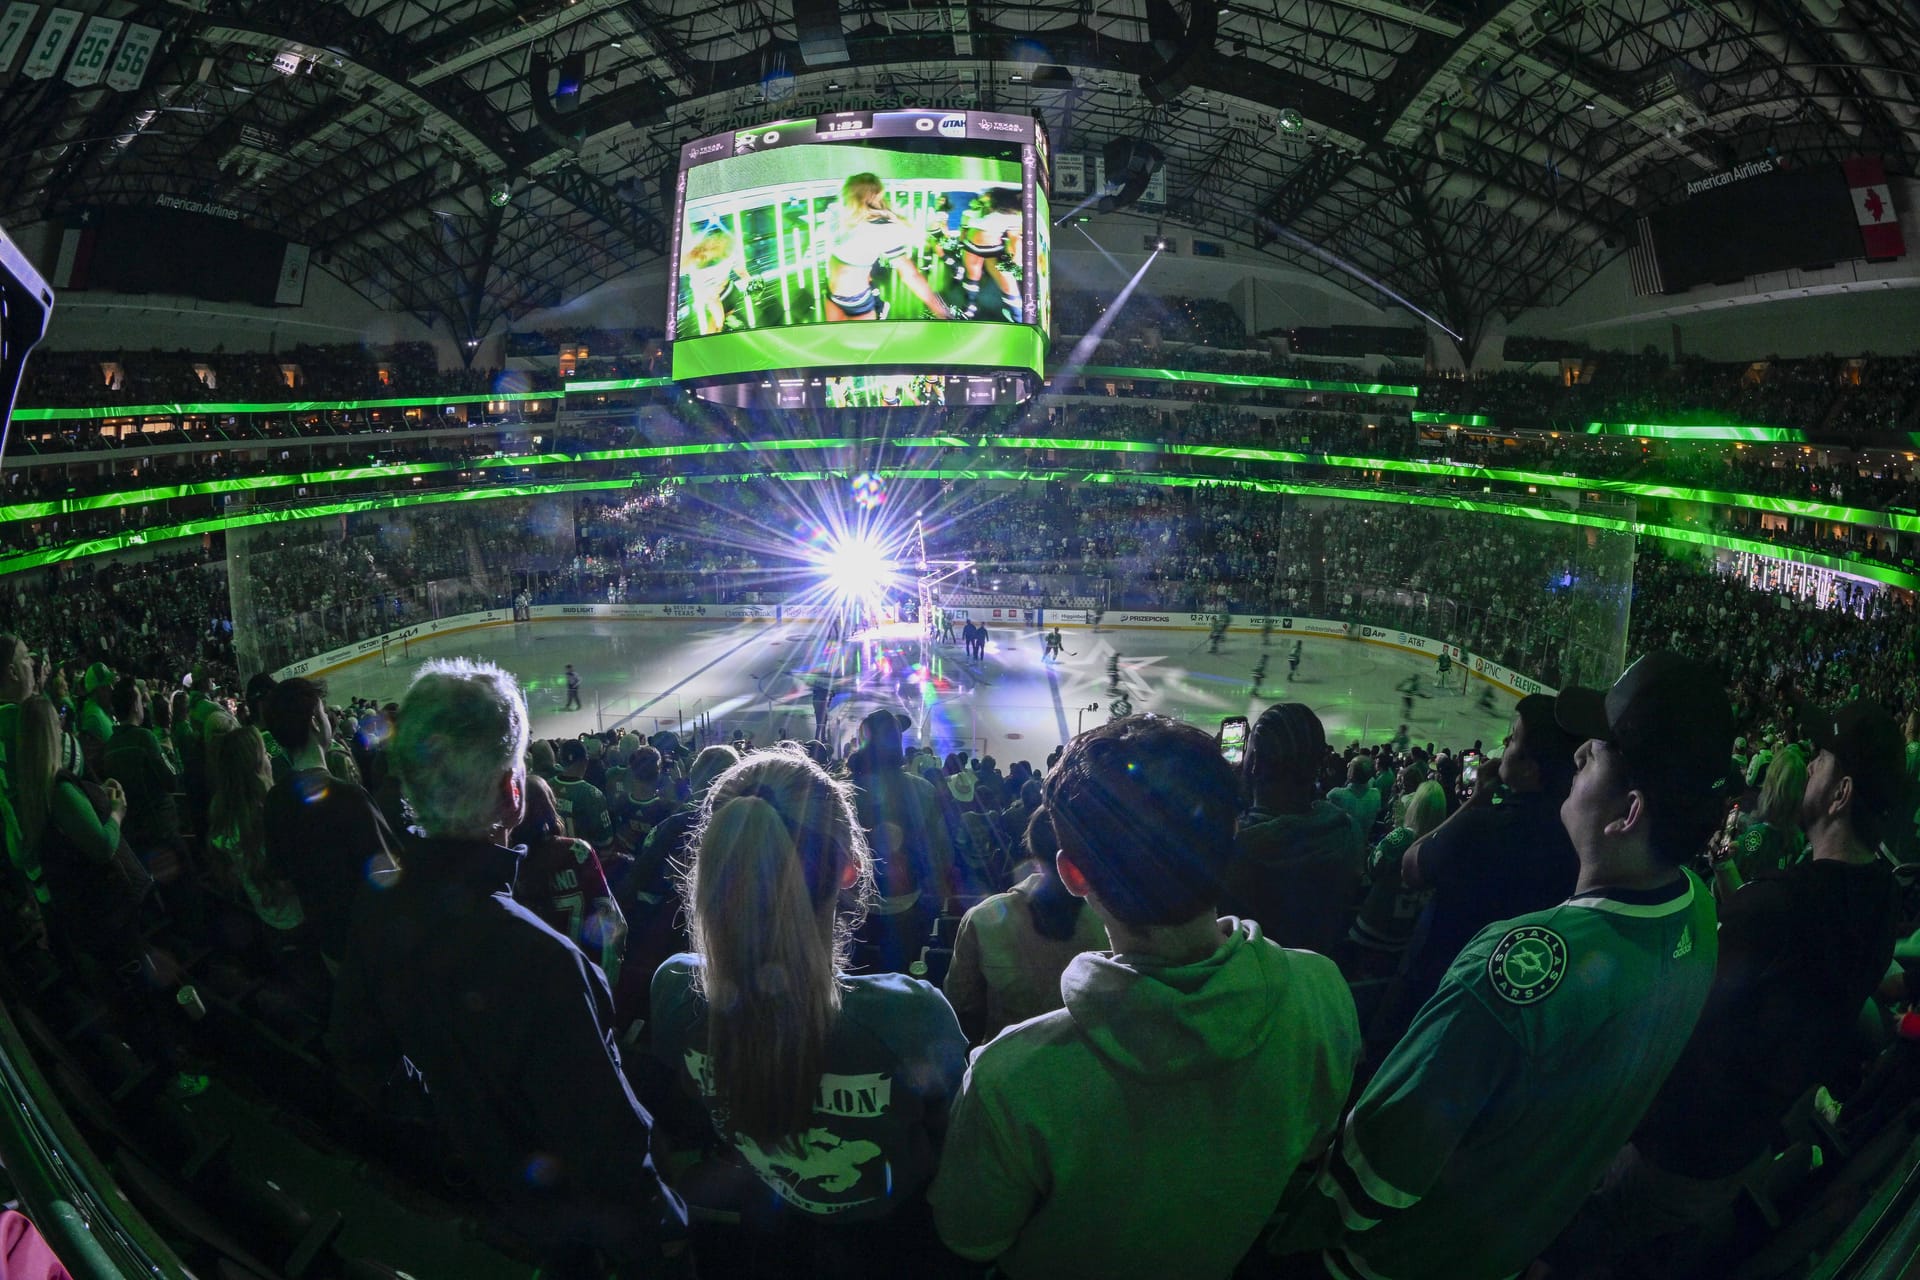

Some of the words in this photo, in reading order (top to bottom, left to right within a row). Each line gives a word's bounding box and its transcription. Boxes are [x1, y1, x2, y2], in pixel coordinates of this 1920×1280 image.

[40, 29, 63, 60] 9
[75, 36, 110, 68] 26
[116, 43, 149, 75] 56
[763, 130, 780, 144] 0
[916, 118, 934, 131] 0
[1687, 172, 1734, 195] American
[1733, 160, 1774, 182] Airlines
[154, 193, 203, 214] American
[202, 202, 240, 221] Airlines
[1129, 615, 1170, 623] PRIZEPICKS
[1407, 637, 1425, 648] AT&T
[293, 663, 309, 675] AT&T
[1483, 662, 1502, 680] PNC
[1513, 929, 1562, 981] DALLAS
[1494, 953, 1535, 999] STARS
